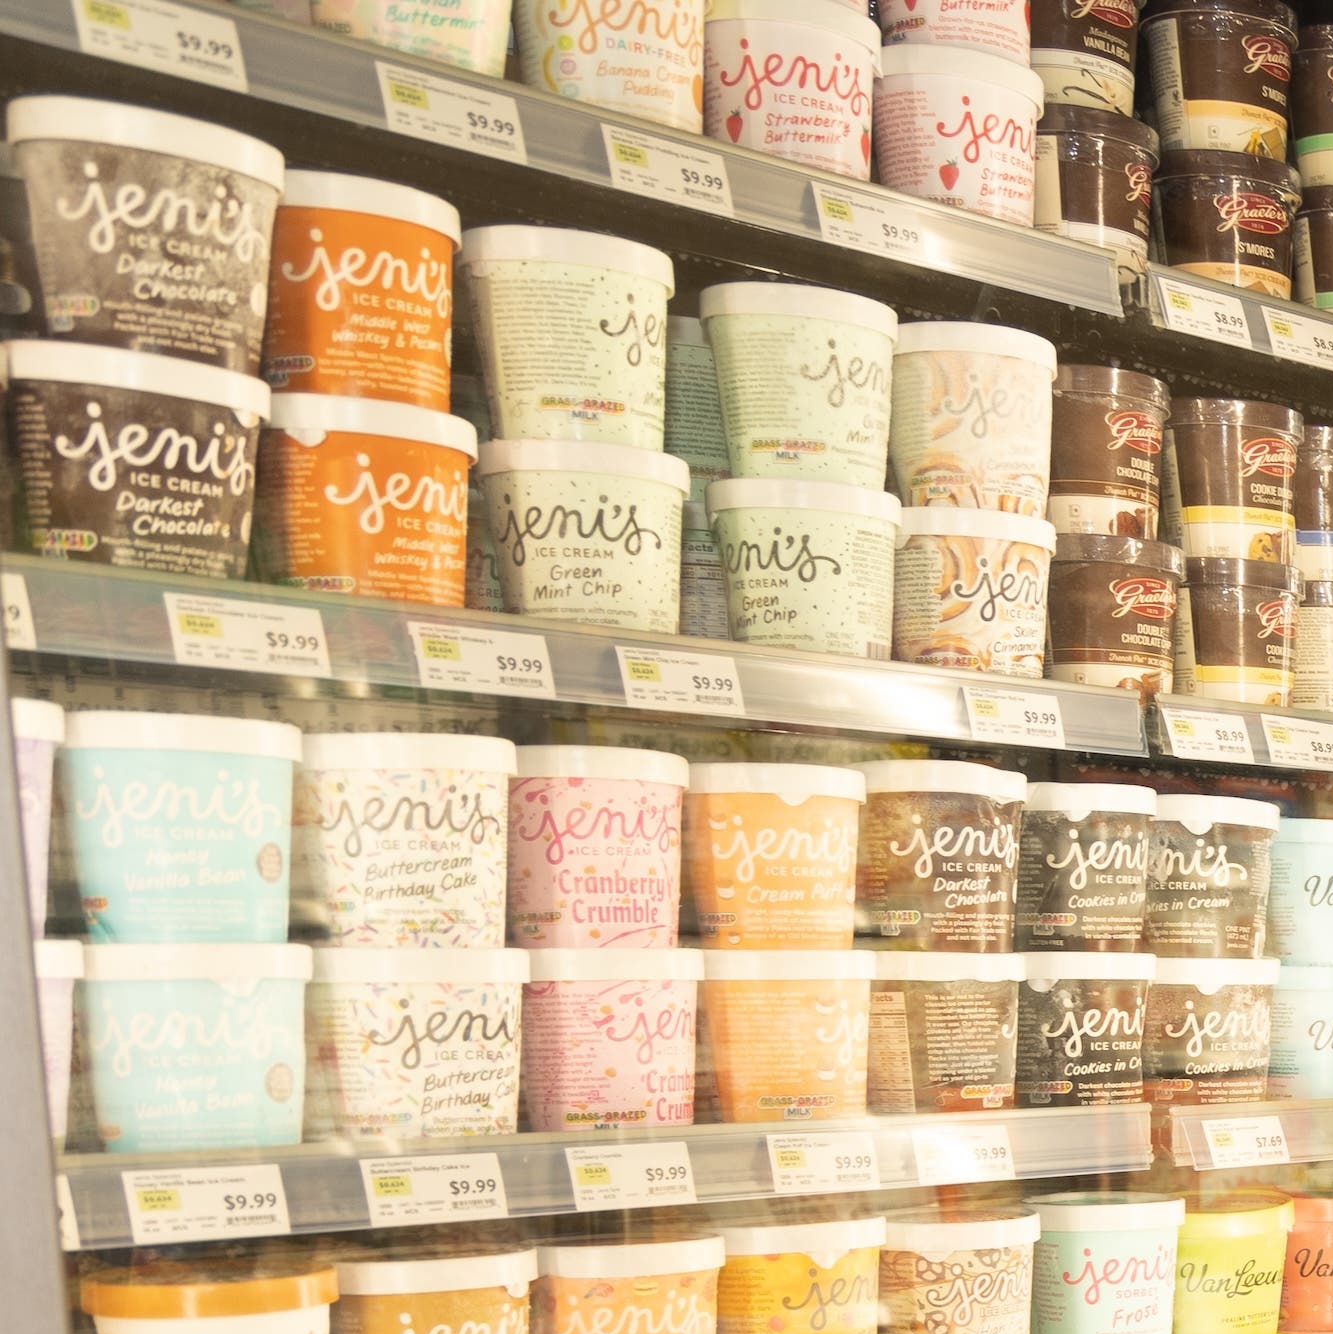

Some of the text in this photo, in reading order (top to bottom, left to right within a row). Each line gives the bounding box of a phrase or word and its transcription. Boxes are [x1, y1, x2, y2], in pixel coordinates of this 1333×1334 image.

[177, 31, 234, 59] $9.99
[596, 62, 651, 80] Banana
[720, 38, 871, 117] jeni's
[623, 80, 675, 101] Pudding
[467, 111, 515, 136] $9.99
[764, 112, 850, 137] Strawberry
[764, 129, 841, 145] Buttermilk
[681, 168, 723, 191] $9.99
[58, 162, 266, 262] jeni's
[882, 223, 918, 243] $9.99
[116, 255, 205, 280] Darkest
[282, 229, 450, 318] jeni's
[134, 278, 238, 307] Chocolate
[1215, 311, 1243, 328] $8.99
[55, 402, 254, 495] jeni's
[116, 491, 204, 516] Darkest
[133, 516, 230, 538] Chocolate
[501, 493, 662, 566] jeni's
[550, 565, 602, 579] Green
[535, 581, 622, 600] Mint Chip
[742, 595, 779, 611] Green
[762, 608, 797, 628] Chip
[266, 631, 319, 651] $9.99
[497, 656, 543, 673] $9.99
[693, 676, 733, 692] $9.99
[1024, 711, 1056, 725] $9.99
[1216, 730, 1244, 743] $8.99
[76, 767, 282, 846] jeni's
[320, 783, 500, 857] jeni's
[518, 795, 677, 864] jeni's
[712, 815, 854, 881] jeni's
[889, 814, 1018, 878] jeni's
[365, 855, 472, 882] Buttercream
[557, 870, 664, 895] Cranberry
[933, 877, 991, 893] Darkest
[1168, 881, 1207, 891] CREAM
[946, 891, 1007, 909] Chocolate
[1069, 894, 1116, 909] Cookies
[572, 899, 658, 923] Crumble
[1185, 1059, 1233, 1074] Cookies
[566, 1111, 646, 1123] GRASS-GRAZED
[1256, 1136, 1282, 1148] $7.69
[836, 1156, 871, 1170] $9.99
[974, 1147, 1006, 1161] $9.99
[646, 1168, 687, 1181] $9.99
[449, 1179, 496, 1196] $9.99
[224, 1194, 277, 1210] $9.99
